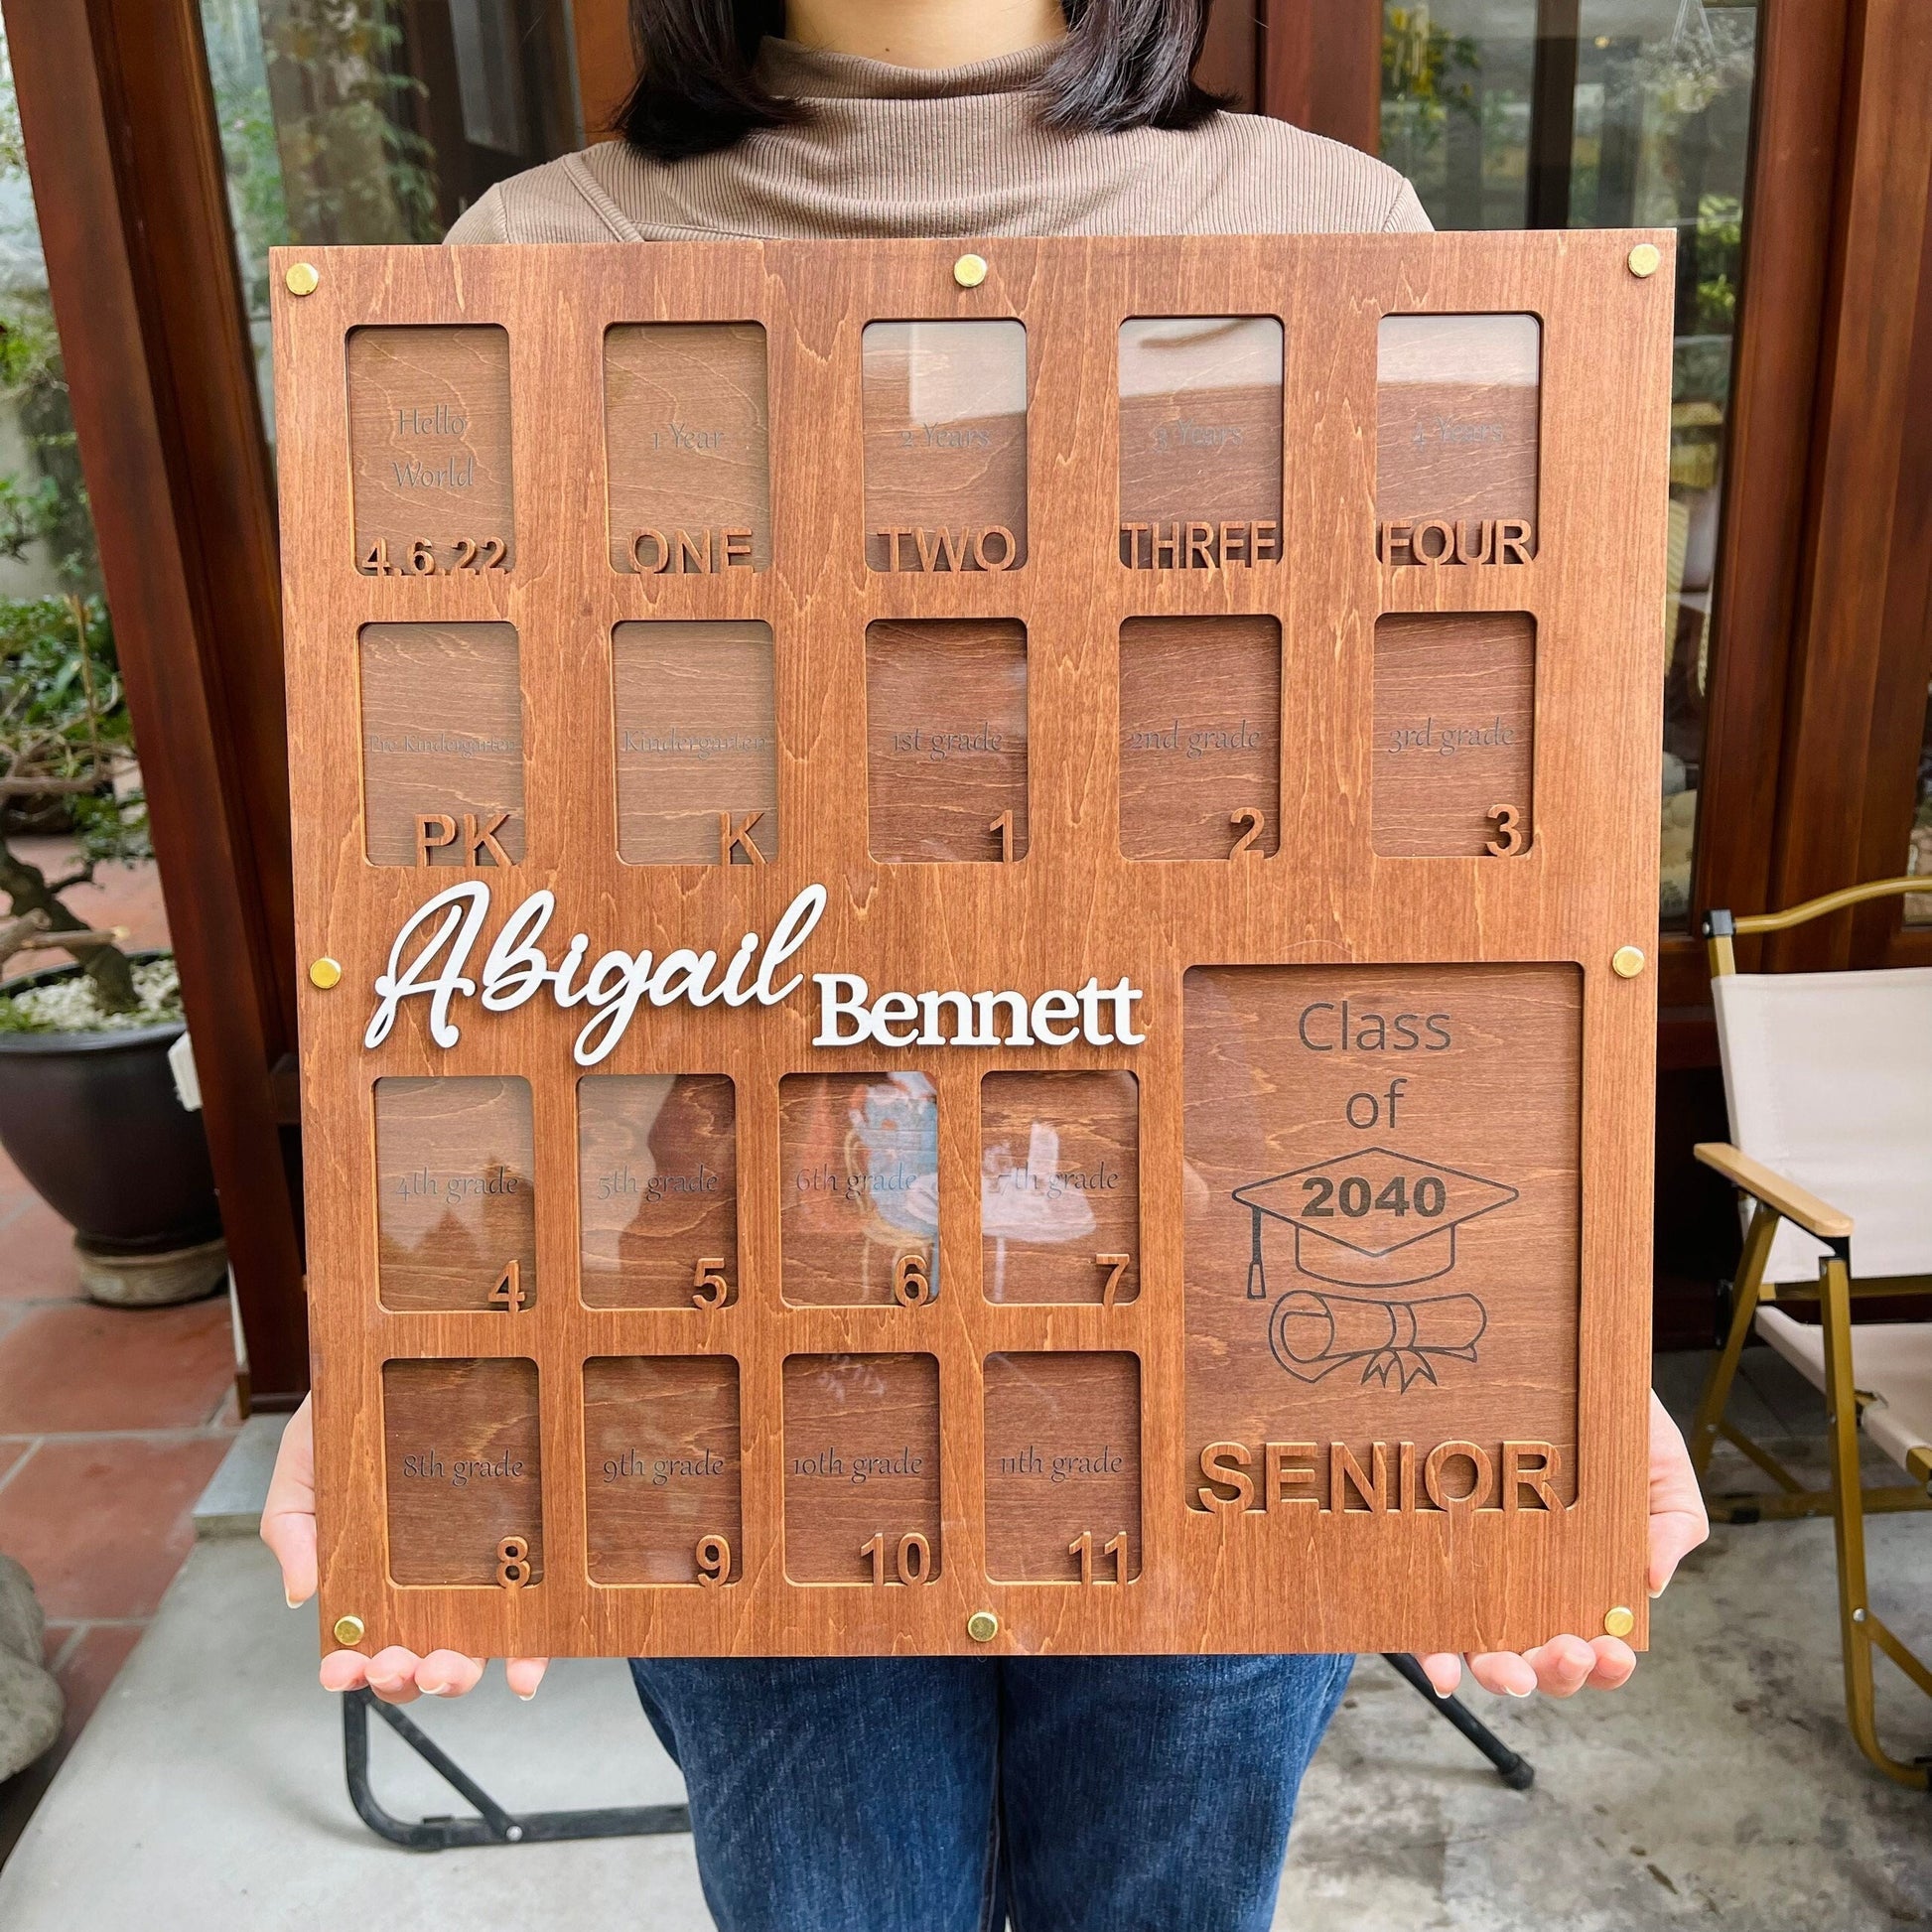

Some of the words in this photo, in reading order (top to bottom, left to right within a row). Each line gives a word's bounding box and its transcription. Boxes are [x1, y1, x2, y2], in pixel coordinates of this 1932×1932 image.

[397, 404, 468, 436] Hello
[651, 431, 660, 450] 1
[668, 421, 725, 450] Year
[900, 429, 913, 448] 2
[922, 421, 991, 448] Years
[1153, 426, 1169, 454] 3
[1175, 418, 1244, 447] Years
[1412, 421, 1426, 453] 4
[1435, 413, 1504, 443] Years
[391, 457, 475, 488] World
[361, 536, 509, 576] 4.6.22
[630, 527, 755, 574] ONE
[877, 525, 1018, 572] TWO
[1121, 520, 1278, 570] THREE
[1381, 518, 1534, 566] FOUR
[370, 735, 398, 754] Pre
[404, 733, 515, 759] Kindergarten
[623, 727, 767, 761] Kindergarten
[894, 727, 921, 753] 1st
[929, 722, 1005, 760] grade
[1130, 719, 1179, 751] 2nd
[1186, 719, 1263, 759] grade
[1388, 716, 1433, 755] 3rd
[1440, 715, 1515, 757] grade
[415, 813, 517, 866] PK
[719, 812, 768, 866] K
[989, 809, 1015, 862] 1
[1230, 807, 1265, 860] 2
[1486, 803, 1522, 857] 3
[364, 880, 828, 1066] Abigail
[812, 973, 1146, 1046] Bennett
[1299, 1000, 1451, 1052] Class
[1345, 1078, 1408, 1130] of
[397, 1166, 437, 1201] 4th
[447, 1166, 519, 1205] grade
[598, 1165, 638, 1201] 5th
[647, 1164, 719, 1203] grade
[796, 1163, 839, 1192] 6th
[846, 1162, 918, 1201] grade
[997, 1162, 1039, 1197] 7th
[1047, 1161, 1120, 1199] grade
[1301, 1176, 1448, 1218] 2040
[487, 1259, 526, 1311] 4
[692, 1257, 728, 1310] 5
[895, 1255, 929, 1307] 6
[1095, 1253, 1130, 1305] 7
[403, 1449, 445, 1478] 8th
[454, 1449, 525, 1487] grade
[604, 1448, 645, 1484] 9th
[654, 1449, 725, 1486] grade
[794, 1447, 844, 1476] 10th
[851, 1447, 923, 1485] grade
[1001, 1445, 1042, 1474] 11th
[1051, 1445, 1124, 1483] grade
[1197, 1441, 1568, 1514] SENIOR
[496, 1535, 531, 1588] 8
[696, 1534, 732, 1587] 9
[860, 1532, 931, 1587] 10
[1068, 1530, 1129, 1586] 11
